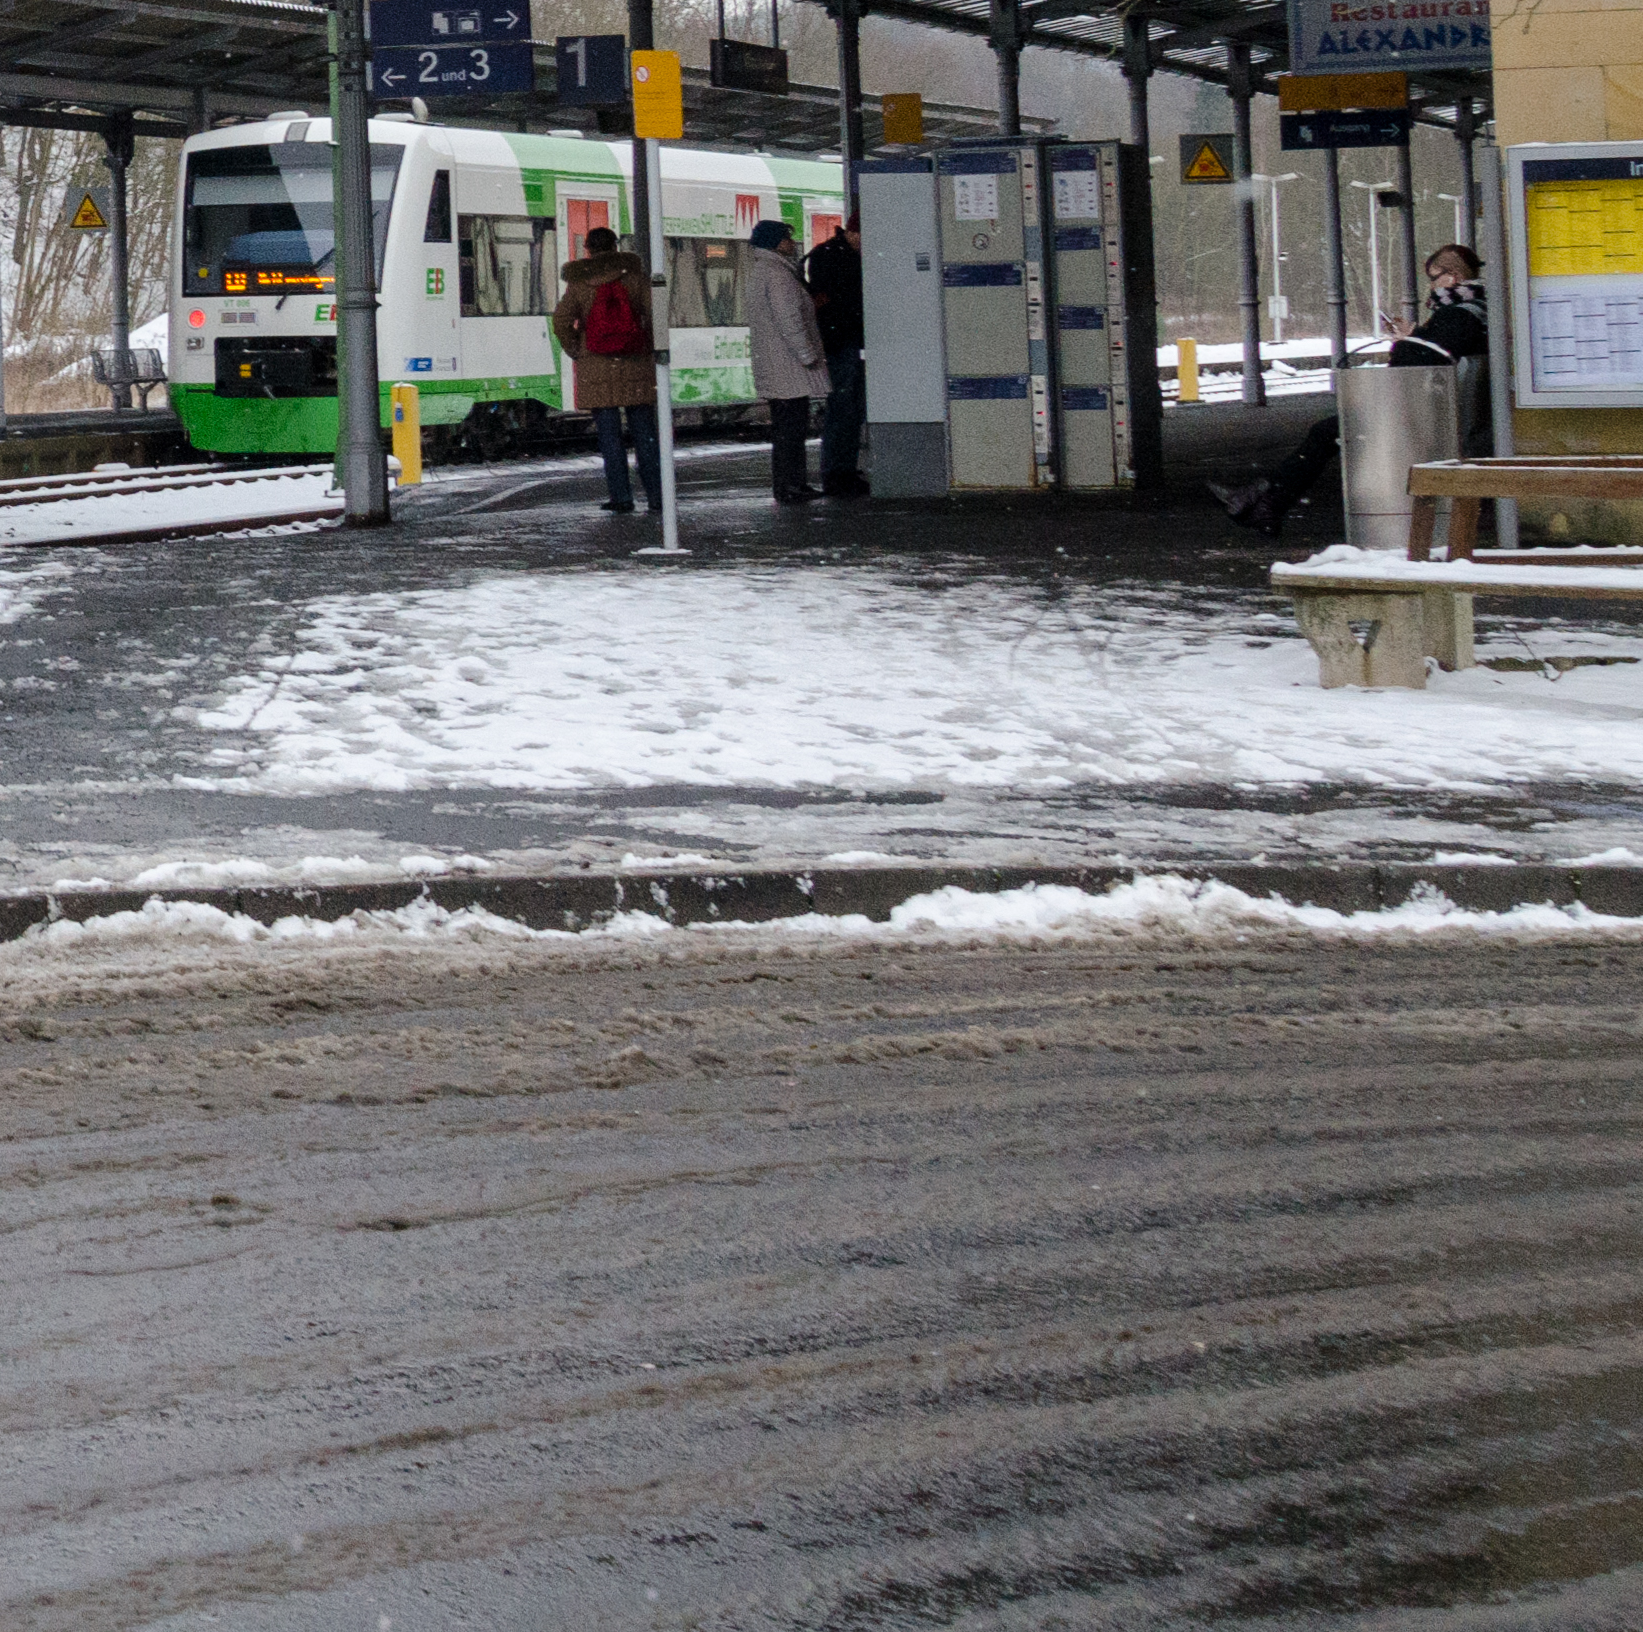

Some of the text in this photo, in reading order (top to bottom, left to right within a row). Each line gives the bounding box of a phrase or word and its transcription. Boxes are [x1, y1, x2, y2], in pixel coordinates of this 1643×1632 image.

[418, 49, 490, 83] 2 und 3
[566, 38, 585, 87] 1
